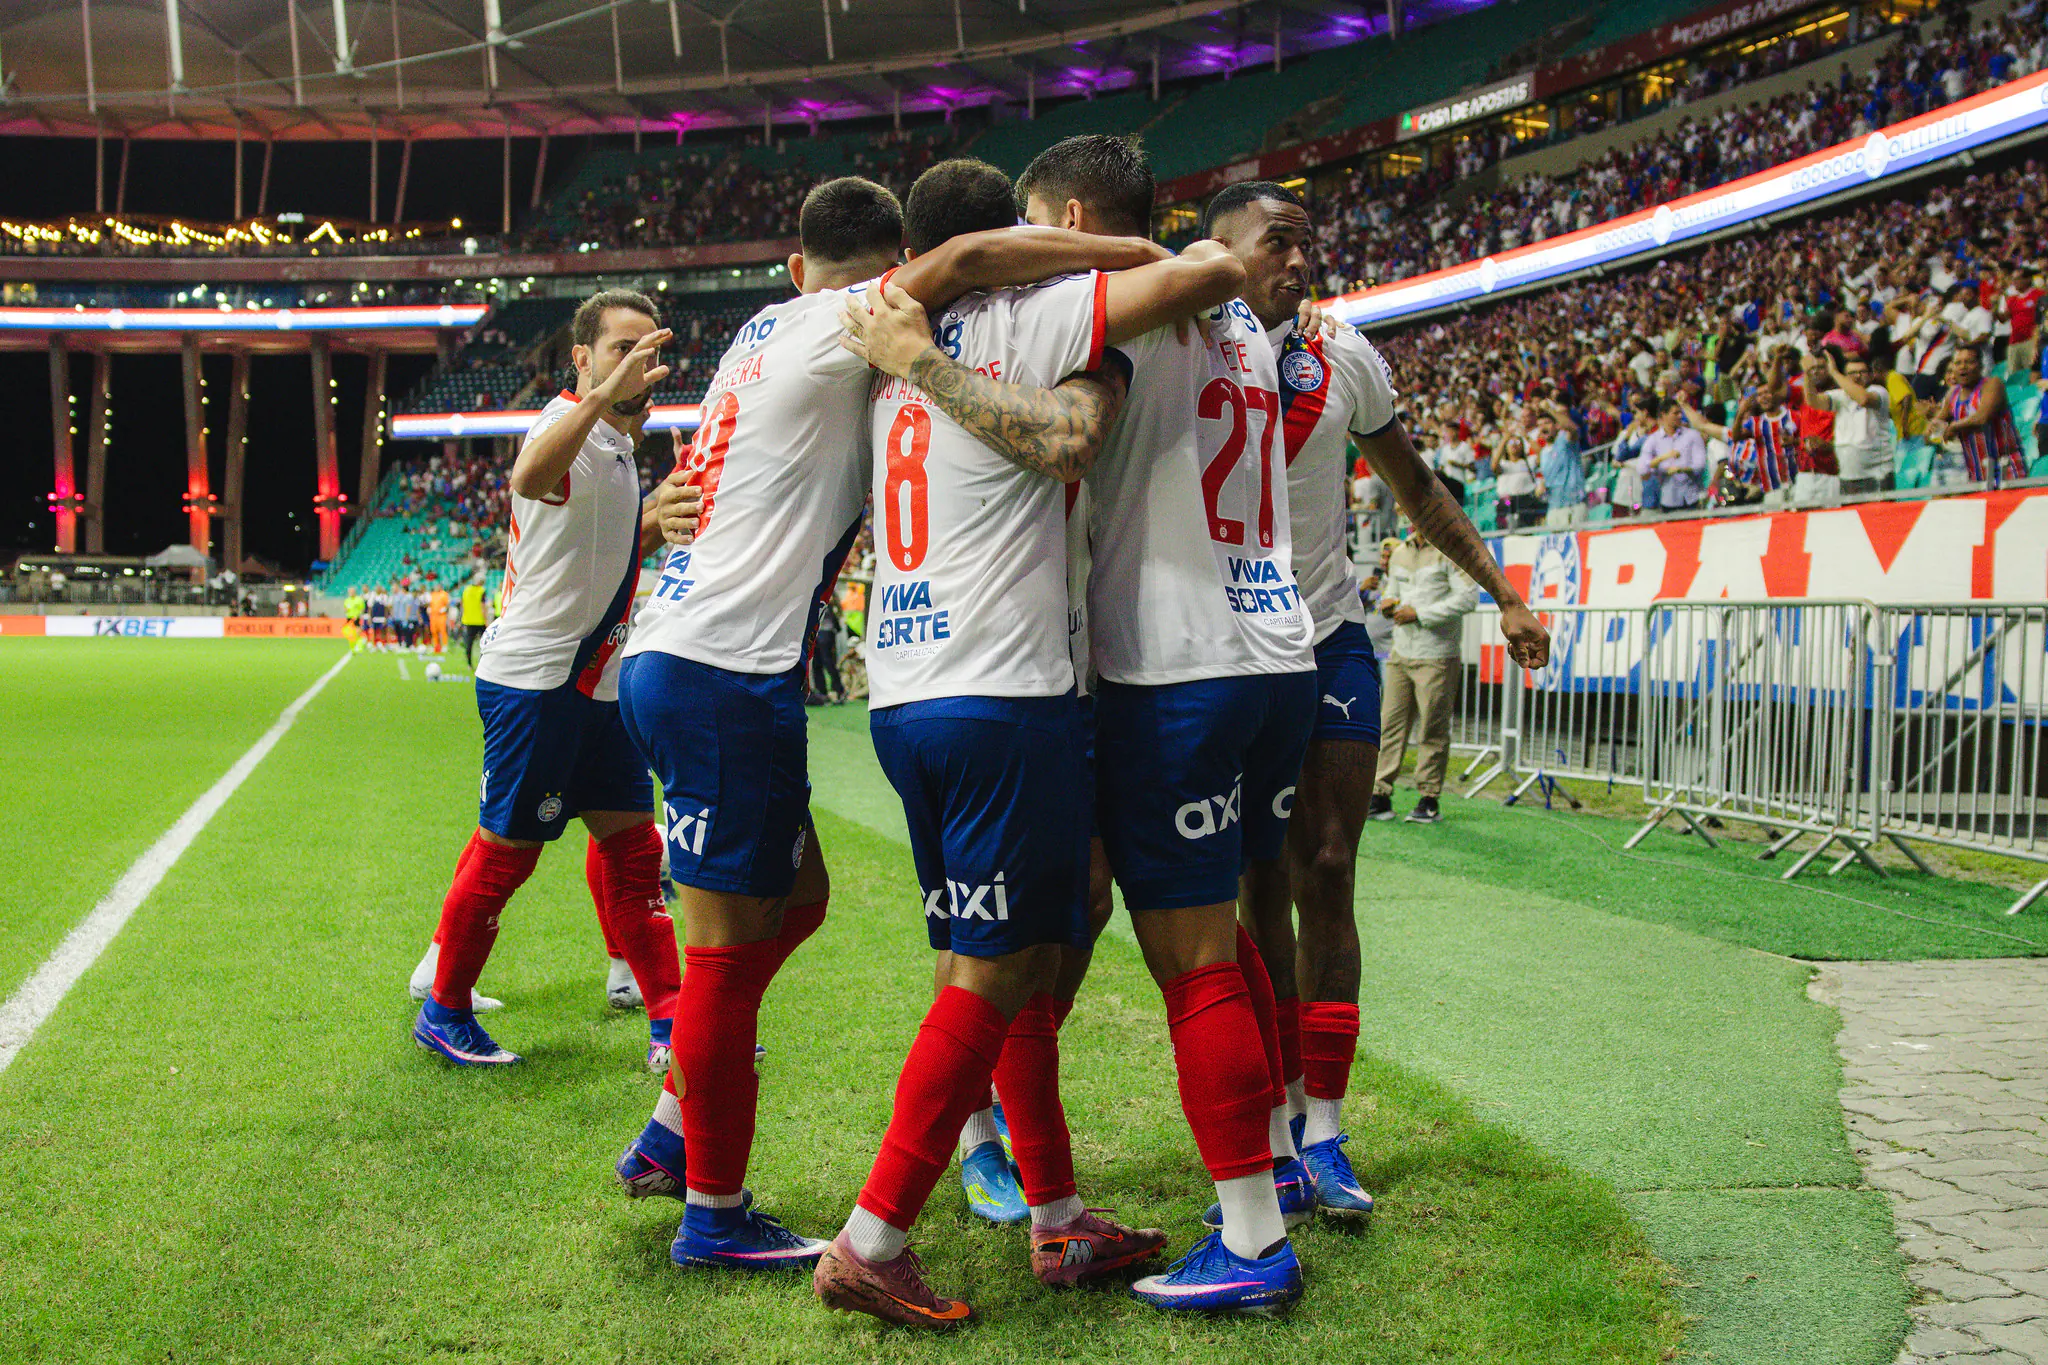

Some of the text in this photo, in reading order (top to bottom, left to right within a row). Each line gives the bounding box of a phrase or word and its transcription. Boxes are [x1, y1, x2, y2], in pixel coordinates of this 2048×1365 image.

[1197, 377, 1279, 549] 27
[885, 403, 933, 572] 8
[1228, 556, 1283, 583] VIVA
[881, 581, 932, 613] VIVA
[93, 619, 175, 637] 1XBET
